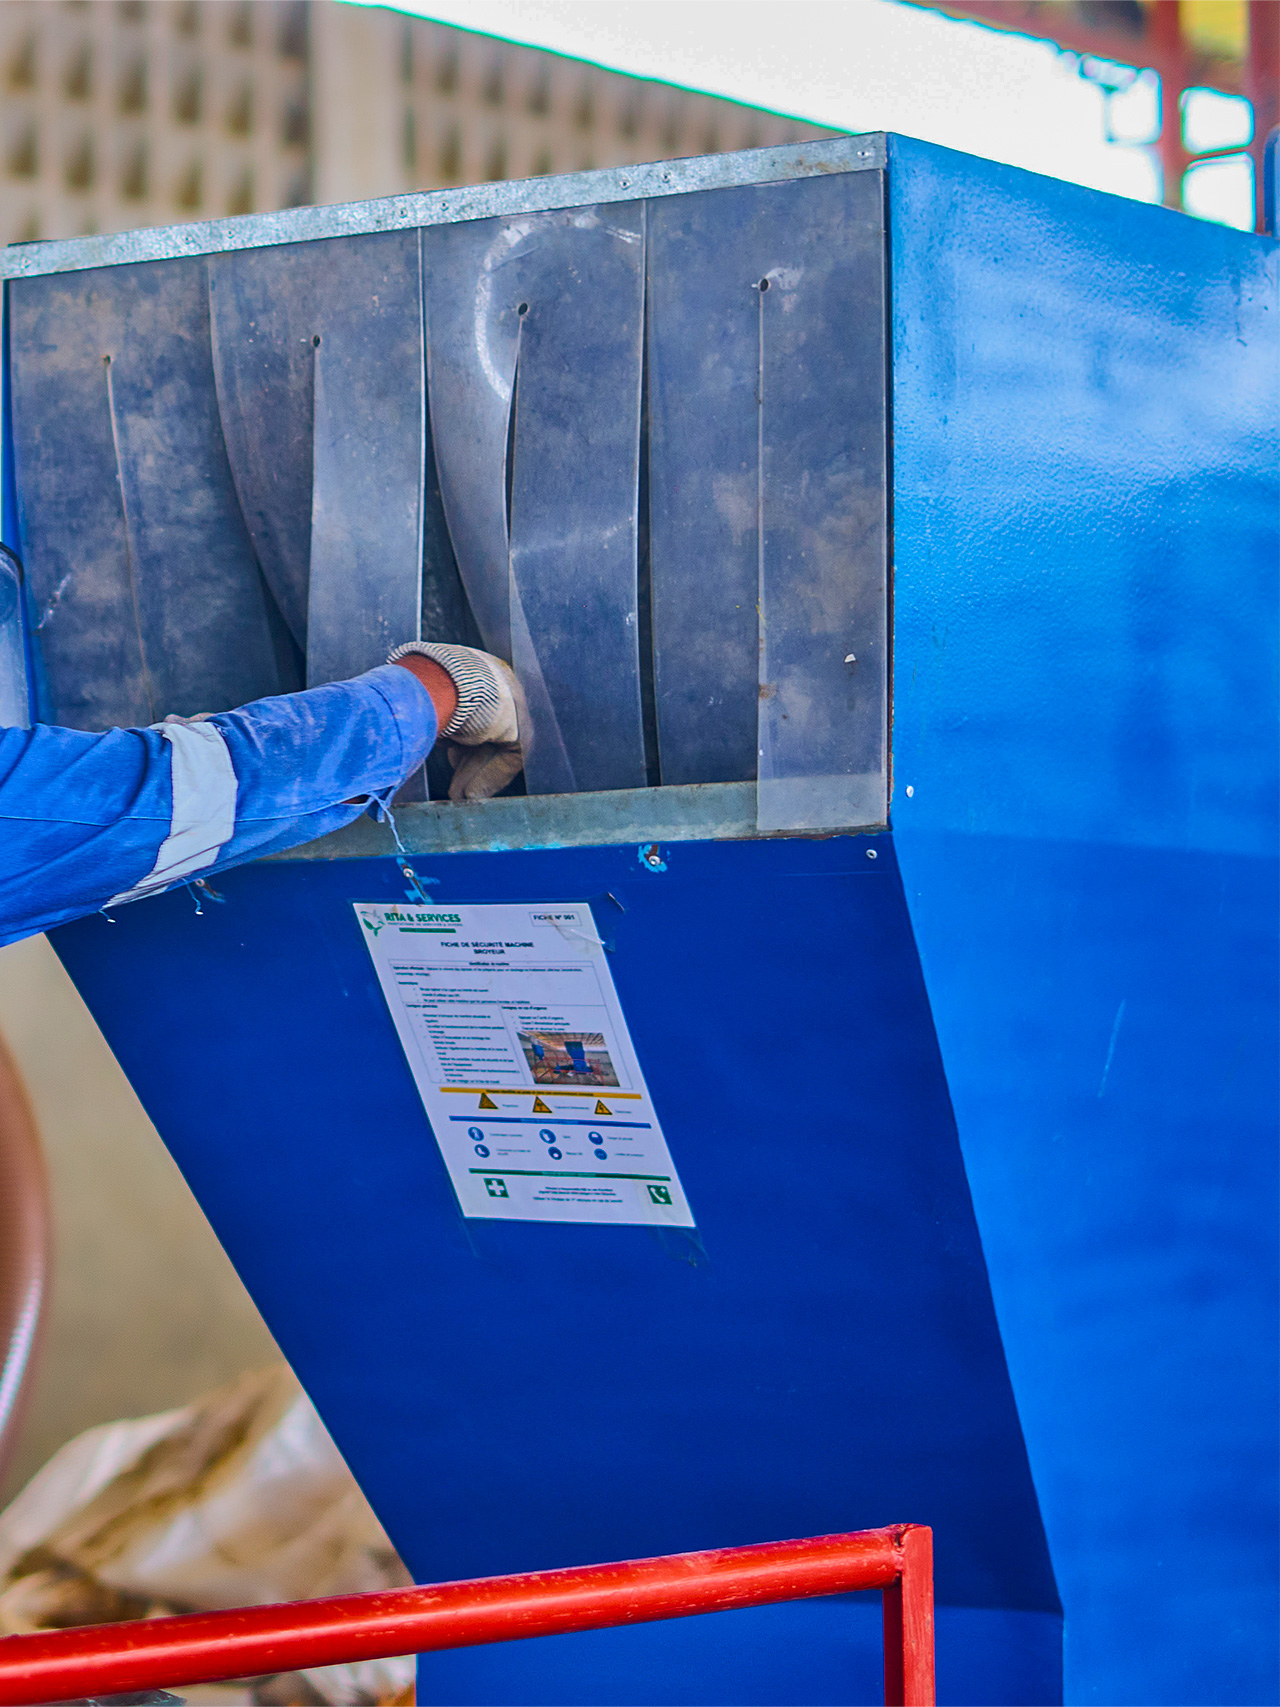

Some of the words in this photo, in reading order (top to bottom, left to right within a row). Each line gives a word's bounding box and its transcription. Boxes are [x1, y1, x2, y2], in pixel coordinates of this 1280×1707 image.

[384, 912, 406, 921] RITA
[407, 913, 414, 922] &
[416, 914, 462, 922] SERVICES
